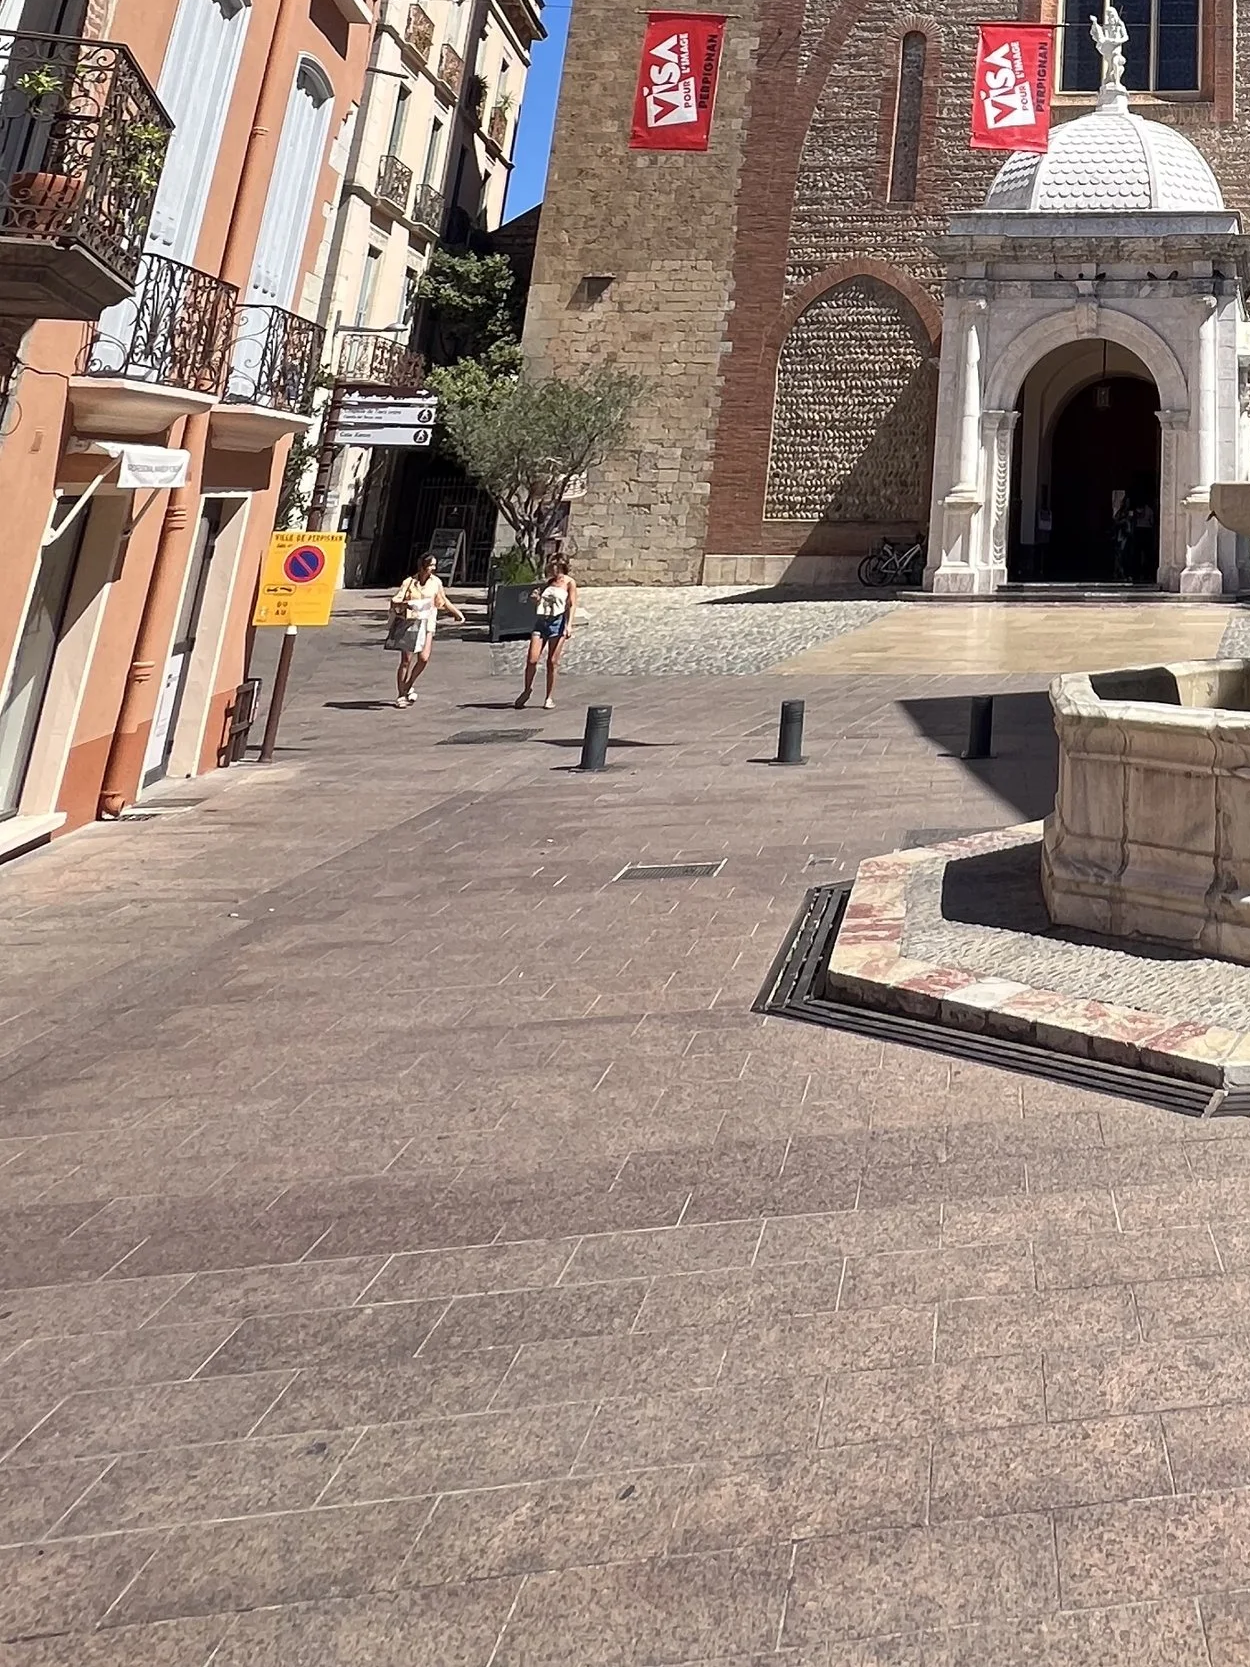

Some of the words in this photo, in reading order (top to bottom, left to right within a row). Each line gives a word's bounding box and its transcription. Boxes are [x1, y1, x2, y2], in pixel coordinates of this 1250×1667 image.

[683, 80, 693, 110] POUR
[697, 34, 719, 110] PERPIGNAN
[1035, 41, 1049, 113] PERPIGNAN
[1018, 85, 1029, 112] POUR
